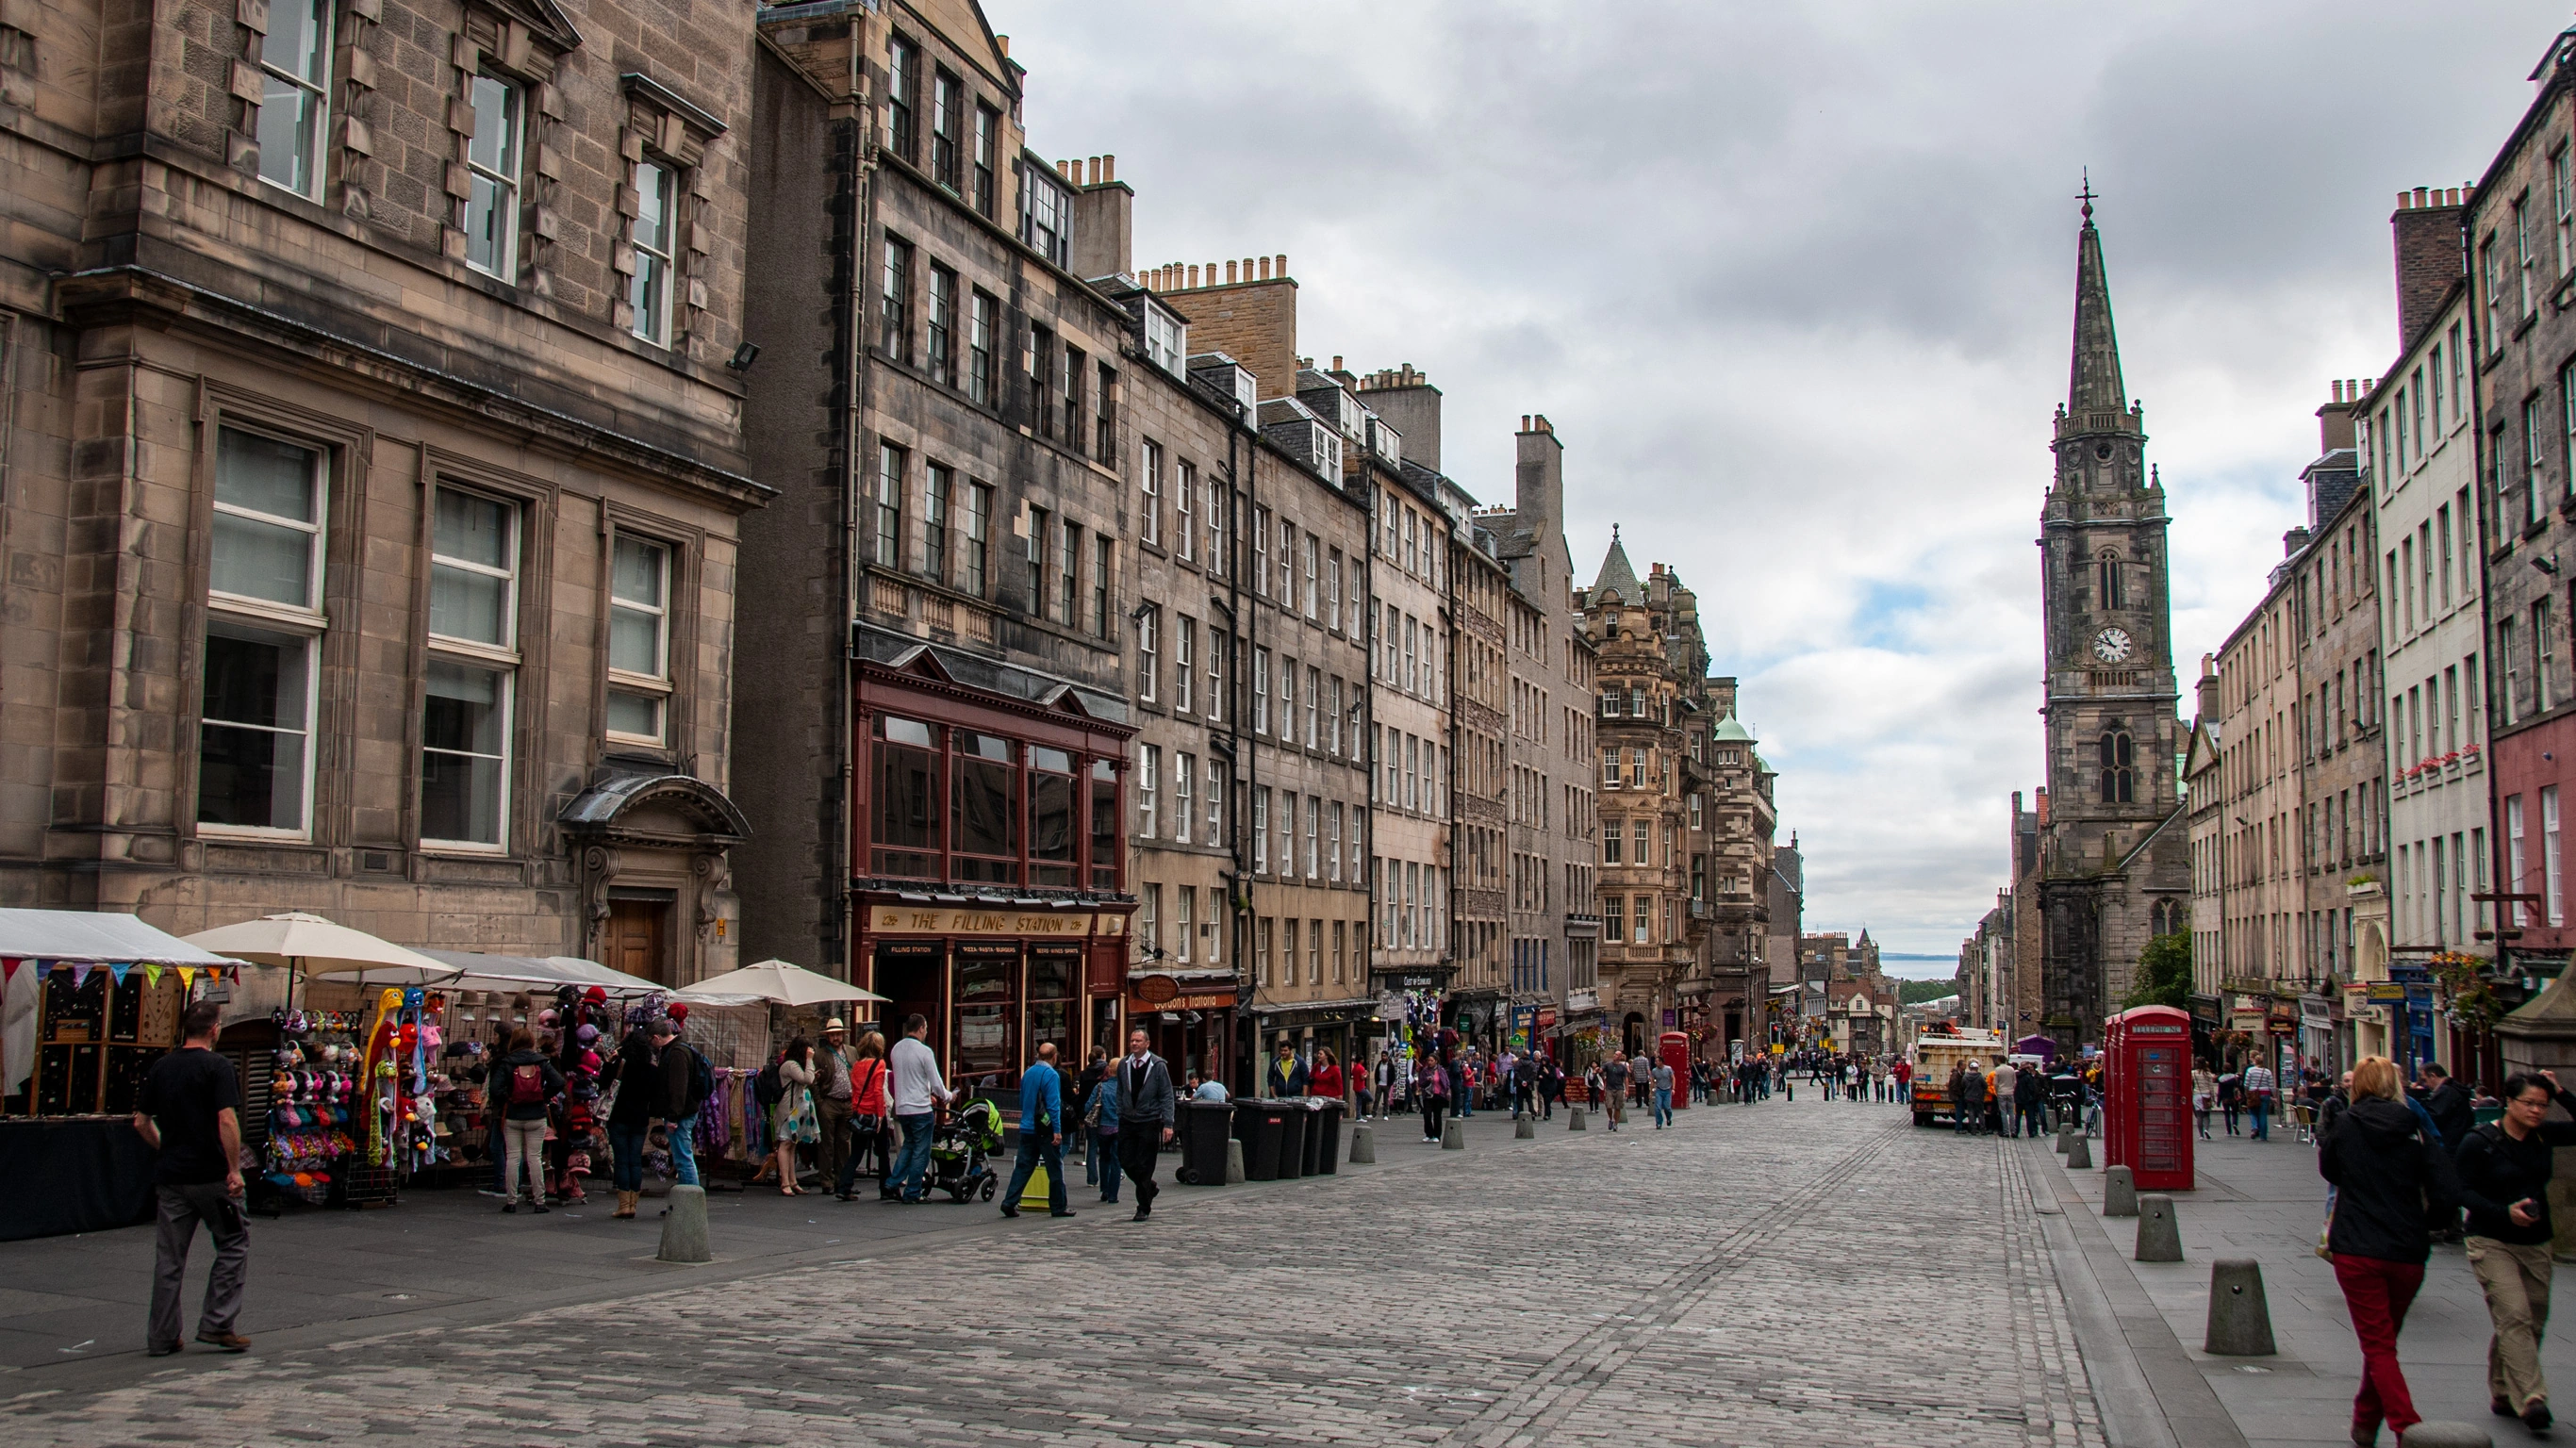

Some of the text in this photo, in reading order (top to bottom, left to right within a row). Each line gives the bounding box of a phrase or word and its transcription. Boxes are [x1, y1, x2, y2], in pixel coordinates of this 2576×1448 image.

[717, 918, 726, 935] H
[912, 913, 940, 930] THE
[952, 913, 1005, 931] FILLING
[1016, 915, 1064, 932] STATION
[1189, 994, 1216, 1008] Trattoria
[2134, 1026, 2180, 1034] TELEPHONE
